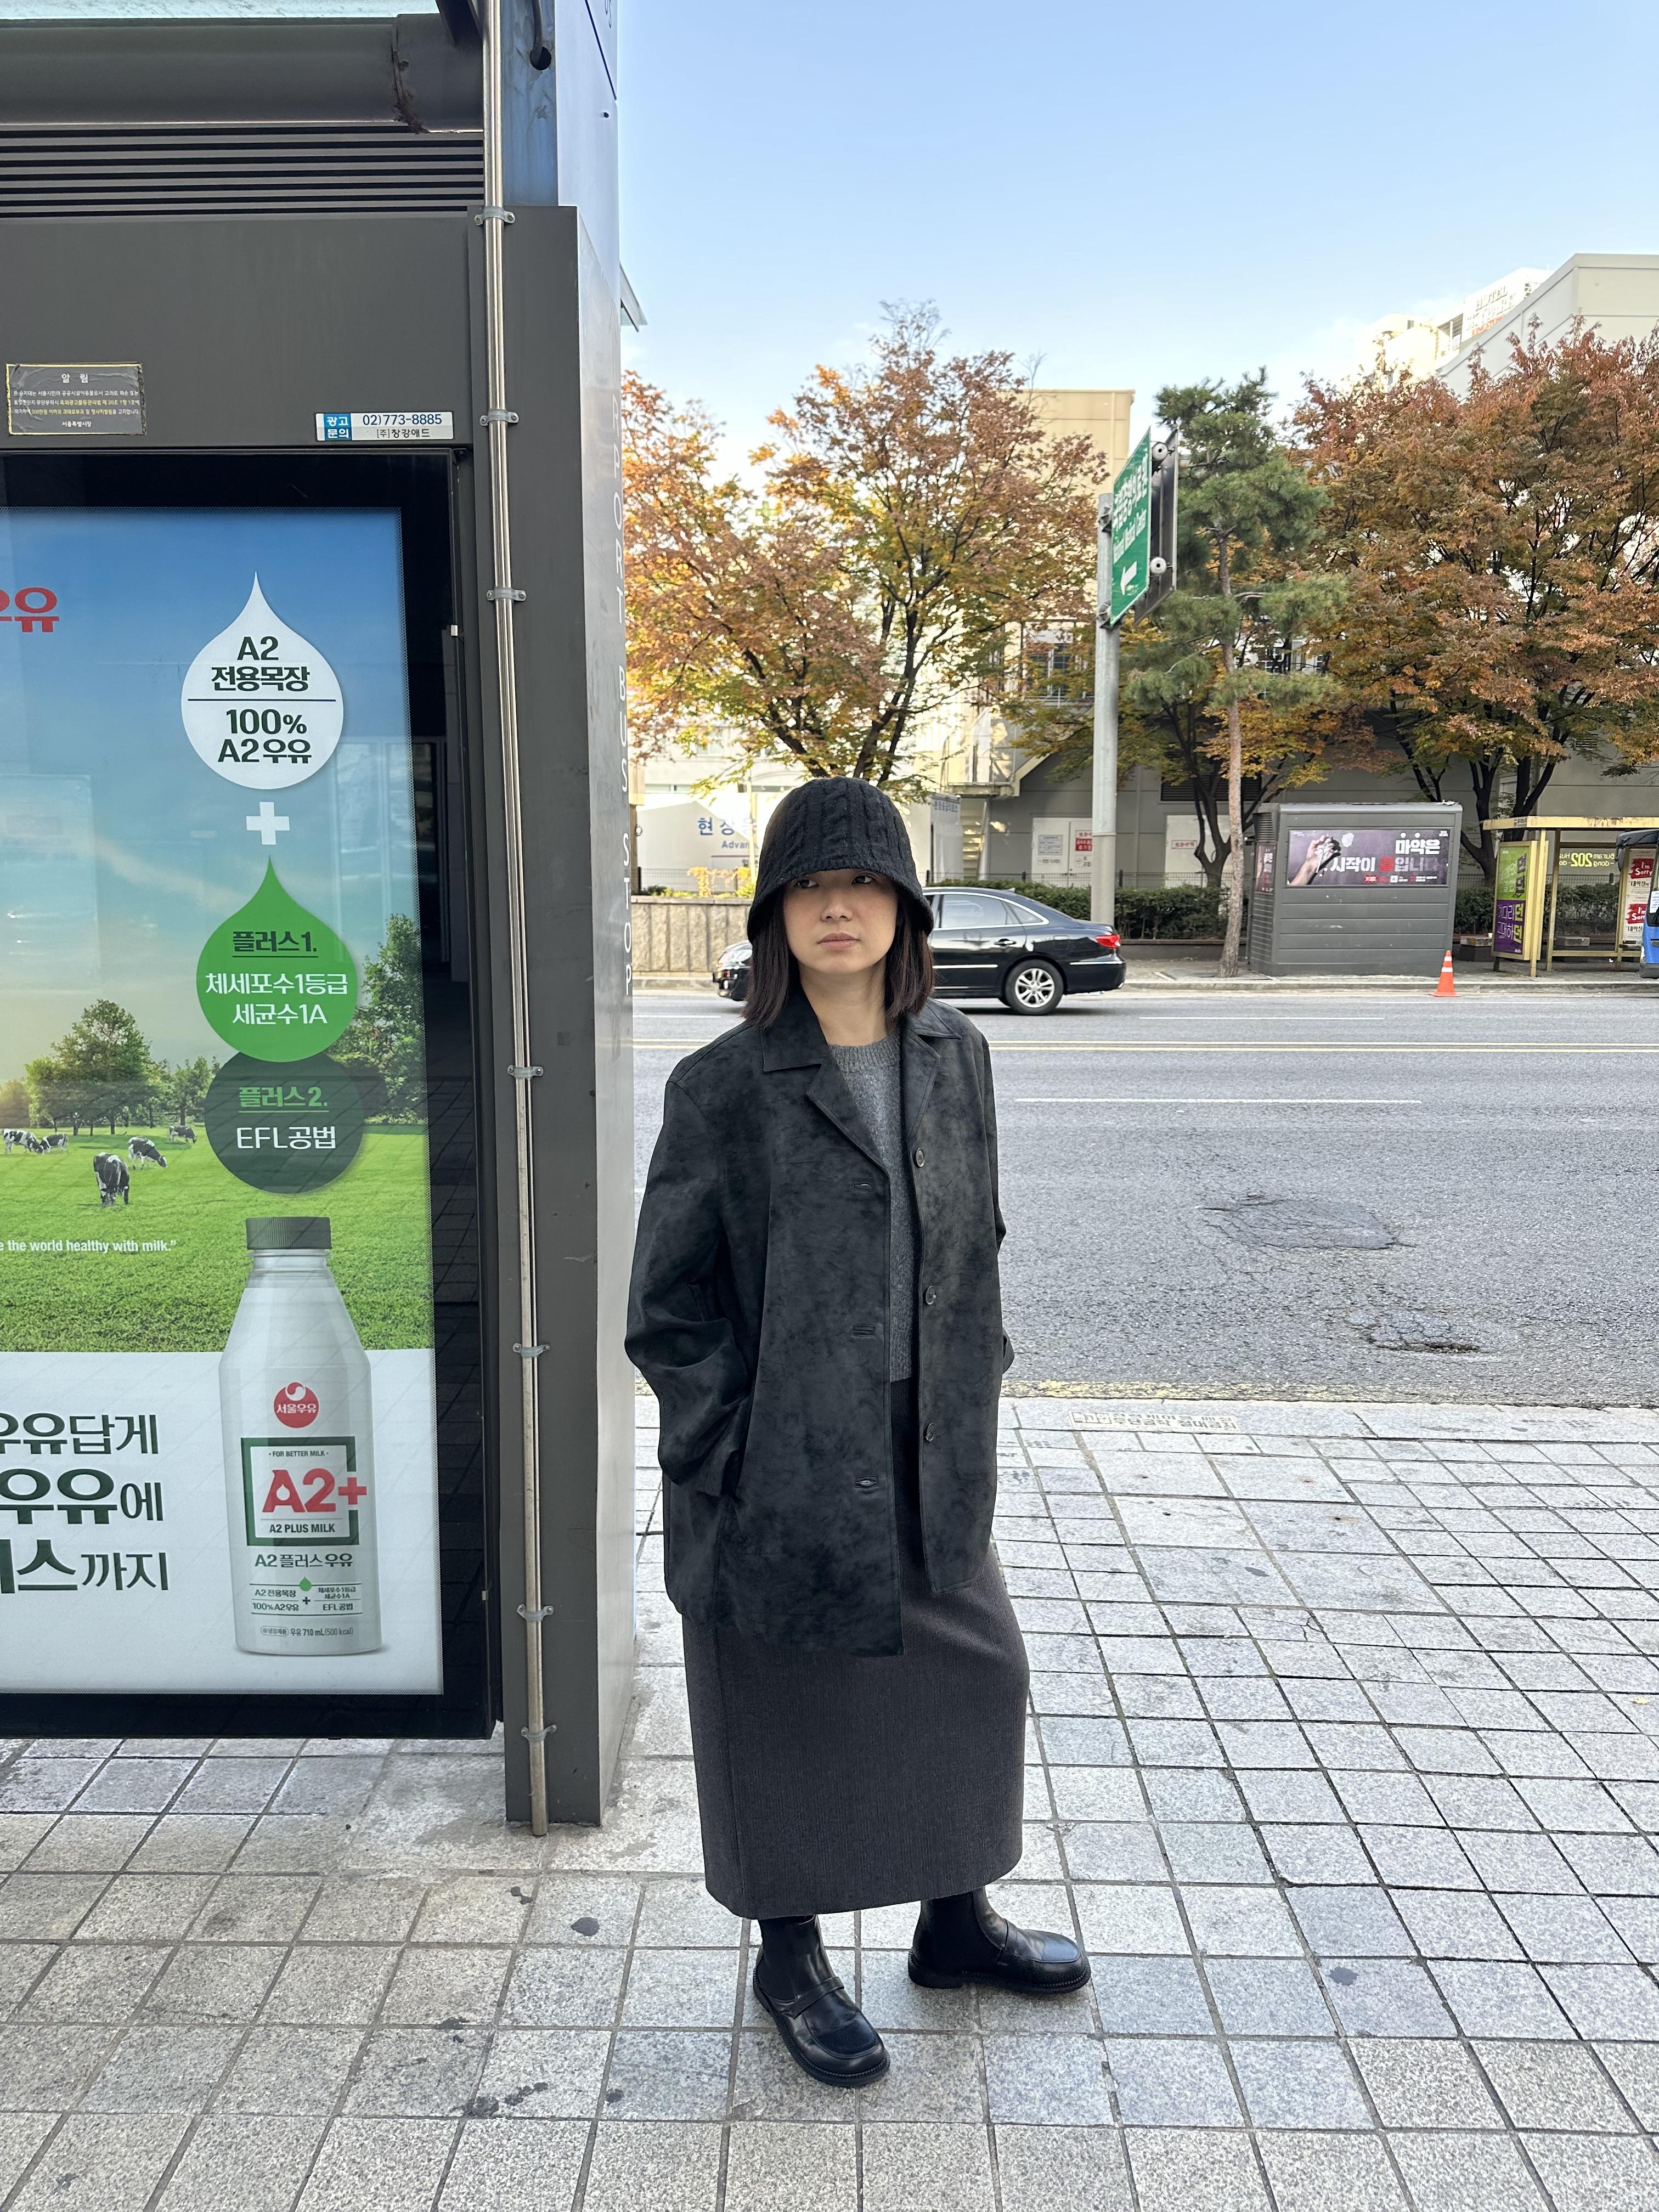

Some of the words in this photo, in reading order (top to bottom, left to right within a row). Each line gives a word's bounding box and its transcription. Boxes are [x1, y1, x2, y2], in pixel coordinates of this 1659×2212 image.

[328, 416, 348, 426] 광고
[363, 414, 442, 425] 02)773-8885
[328, 428, 349, 438] 문의
[0, 587, 59, 633] 유
[238, 636, 279, 661] A2
[211, 666, 310, 691] 전용목장
[226, 709, 307, 734] 100%
[218, 738, 312, 763] A2우유
[1395, 839, 1441, 855] 마약은
[1330, 857, 1376, 872] 시작이
[1635, 868, 1652, 876] Sorry
[623, 833, 631, 996] STOP
[206, 973, 348, 995] 체세포수1등급
[232, 1004, 328, 1025] 세균수1A
[236, 1126, 336, 1149] EFL공법
[8, 1240, 26, 1251] the
[30, 1240, 63, 1251] world
[66, 1240, 109, 1254] healthy
[112, 1240, 138, 1251] with
[276, 1403, 317, 1414] 서울우유
[1178, 1420, 1237, 1429] 절대금지
[0, 1469, 163, 1524] 우유에
[269, 1525, 282, 1533] A2
[285, 1524, 308, 1533] PLUS
[312, 1523, 335, 1532] MILK
[0, 1539, 168, 1594] 스까지
